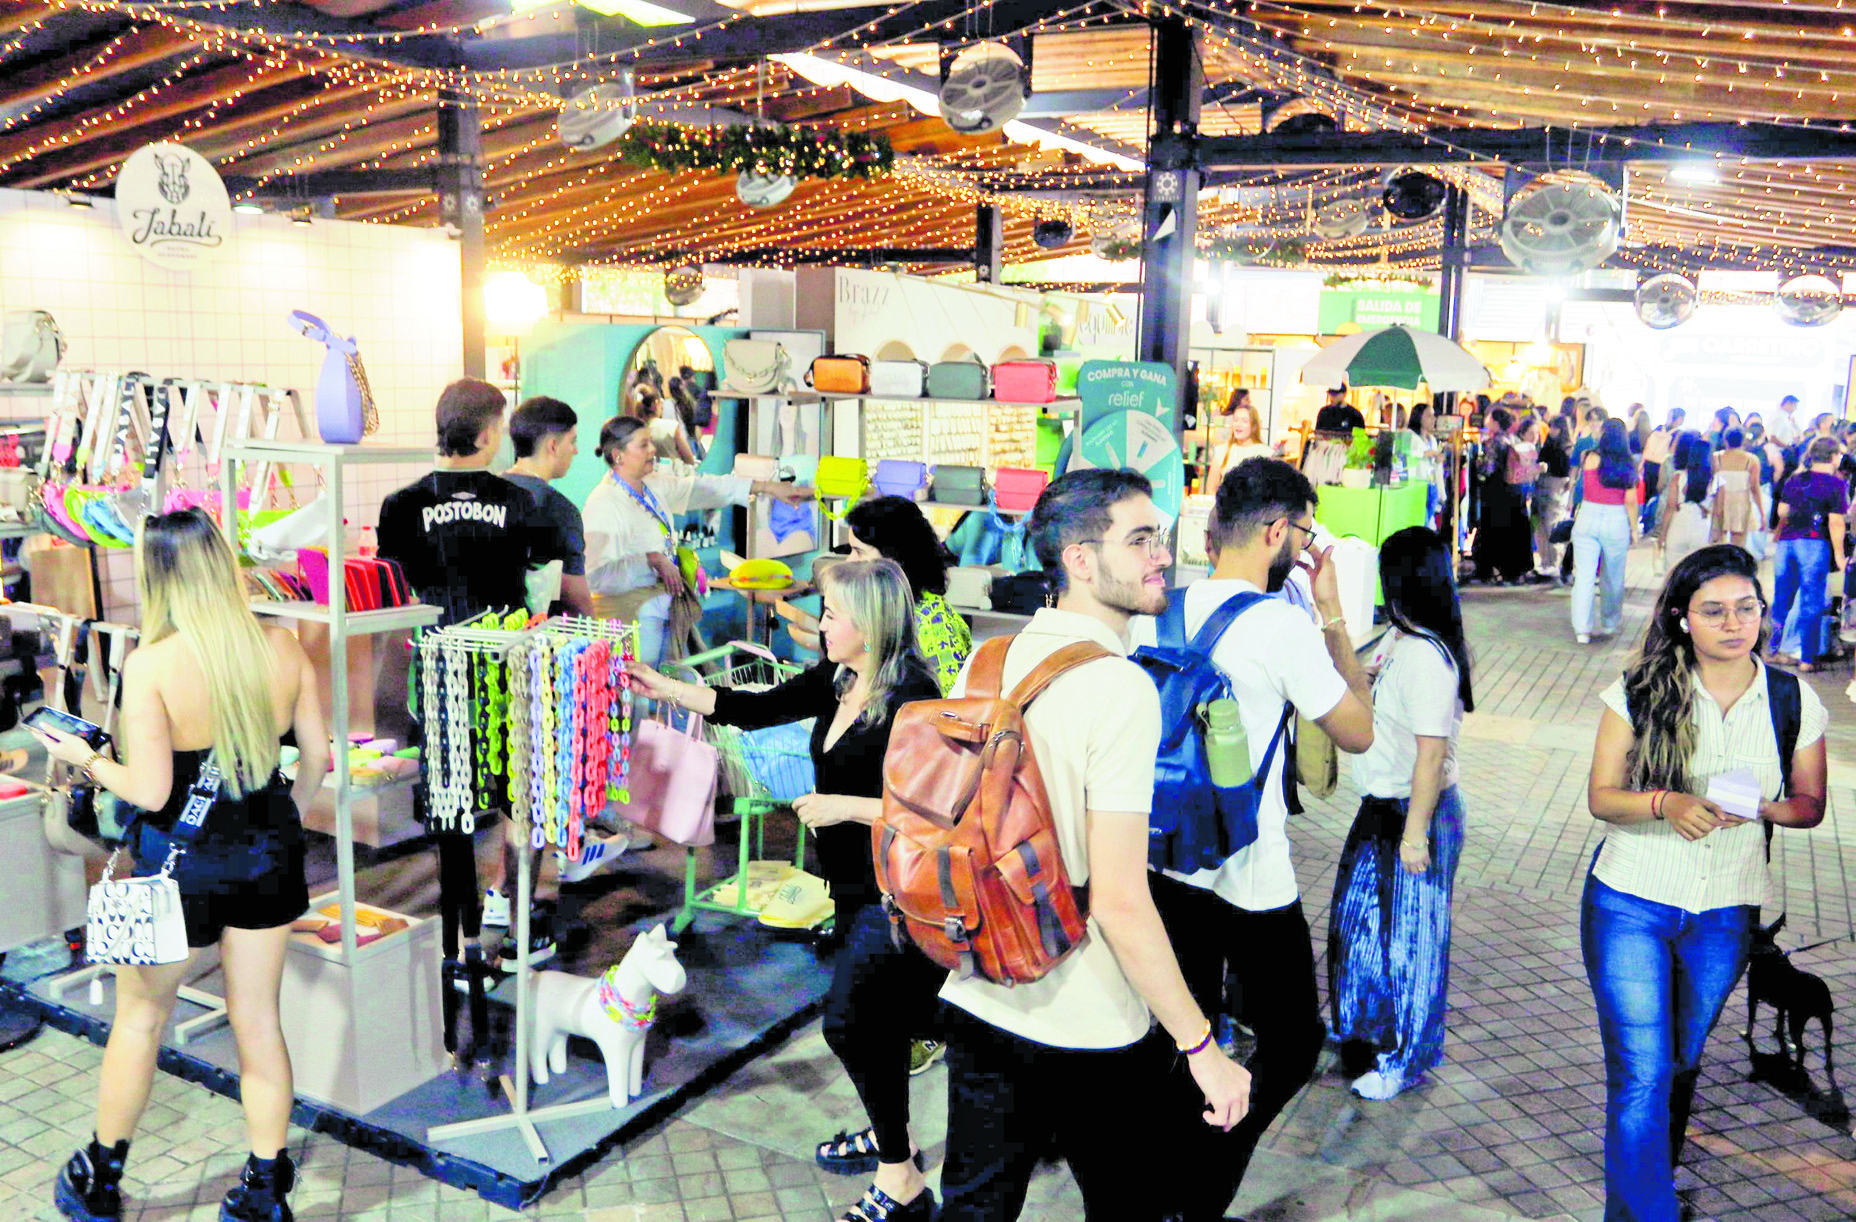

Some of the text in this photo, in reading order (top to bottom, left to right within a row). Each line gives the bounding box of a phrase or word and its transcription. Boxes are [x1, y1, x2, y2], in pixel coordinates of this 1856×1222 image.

[840, 276, 889, 305] Brazz
[1356, 298, 1422, 315] SALIDA DE
[1087, 367, 1167, 387] COMPRA Y GANA
[1108, 390, 1145, 408] relief
[422, 501, 507, 533] POSTOBON
